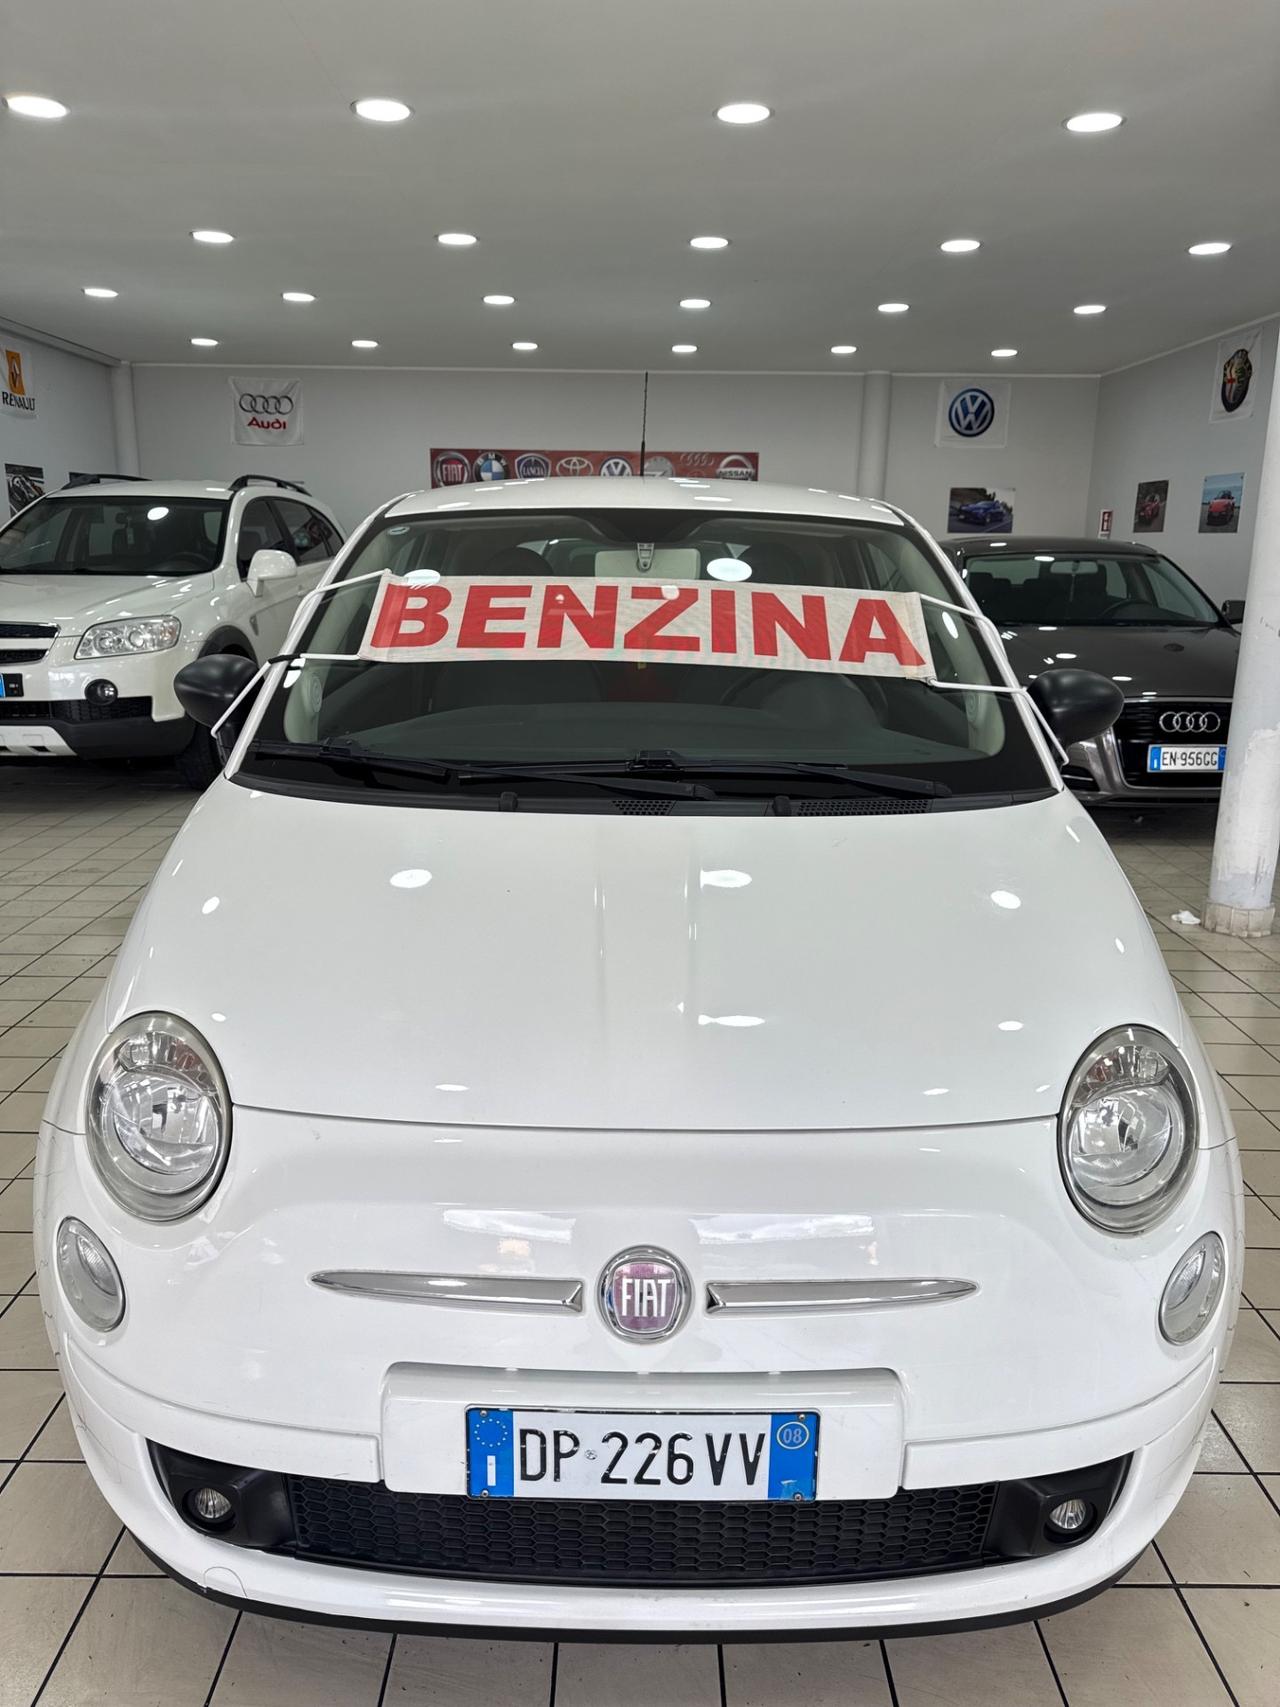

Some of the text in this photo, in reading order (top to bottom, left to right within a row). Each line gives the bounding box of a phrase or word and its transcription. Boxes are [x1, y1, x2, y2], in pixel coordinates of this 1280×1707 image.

[247, 416, 287, 430] Audi
[442, 464, 463, 484] FIAT
[370, 584, 926, 666] BENZINA
[621, 1278, 671, 1318] FIAT
[783, 1429, 803, 1444] 08
[519, 1428, 580, 1482] DP
